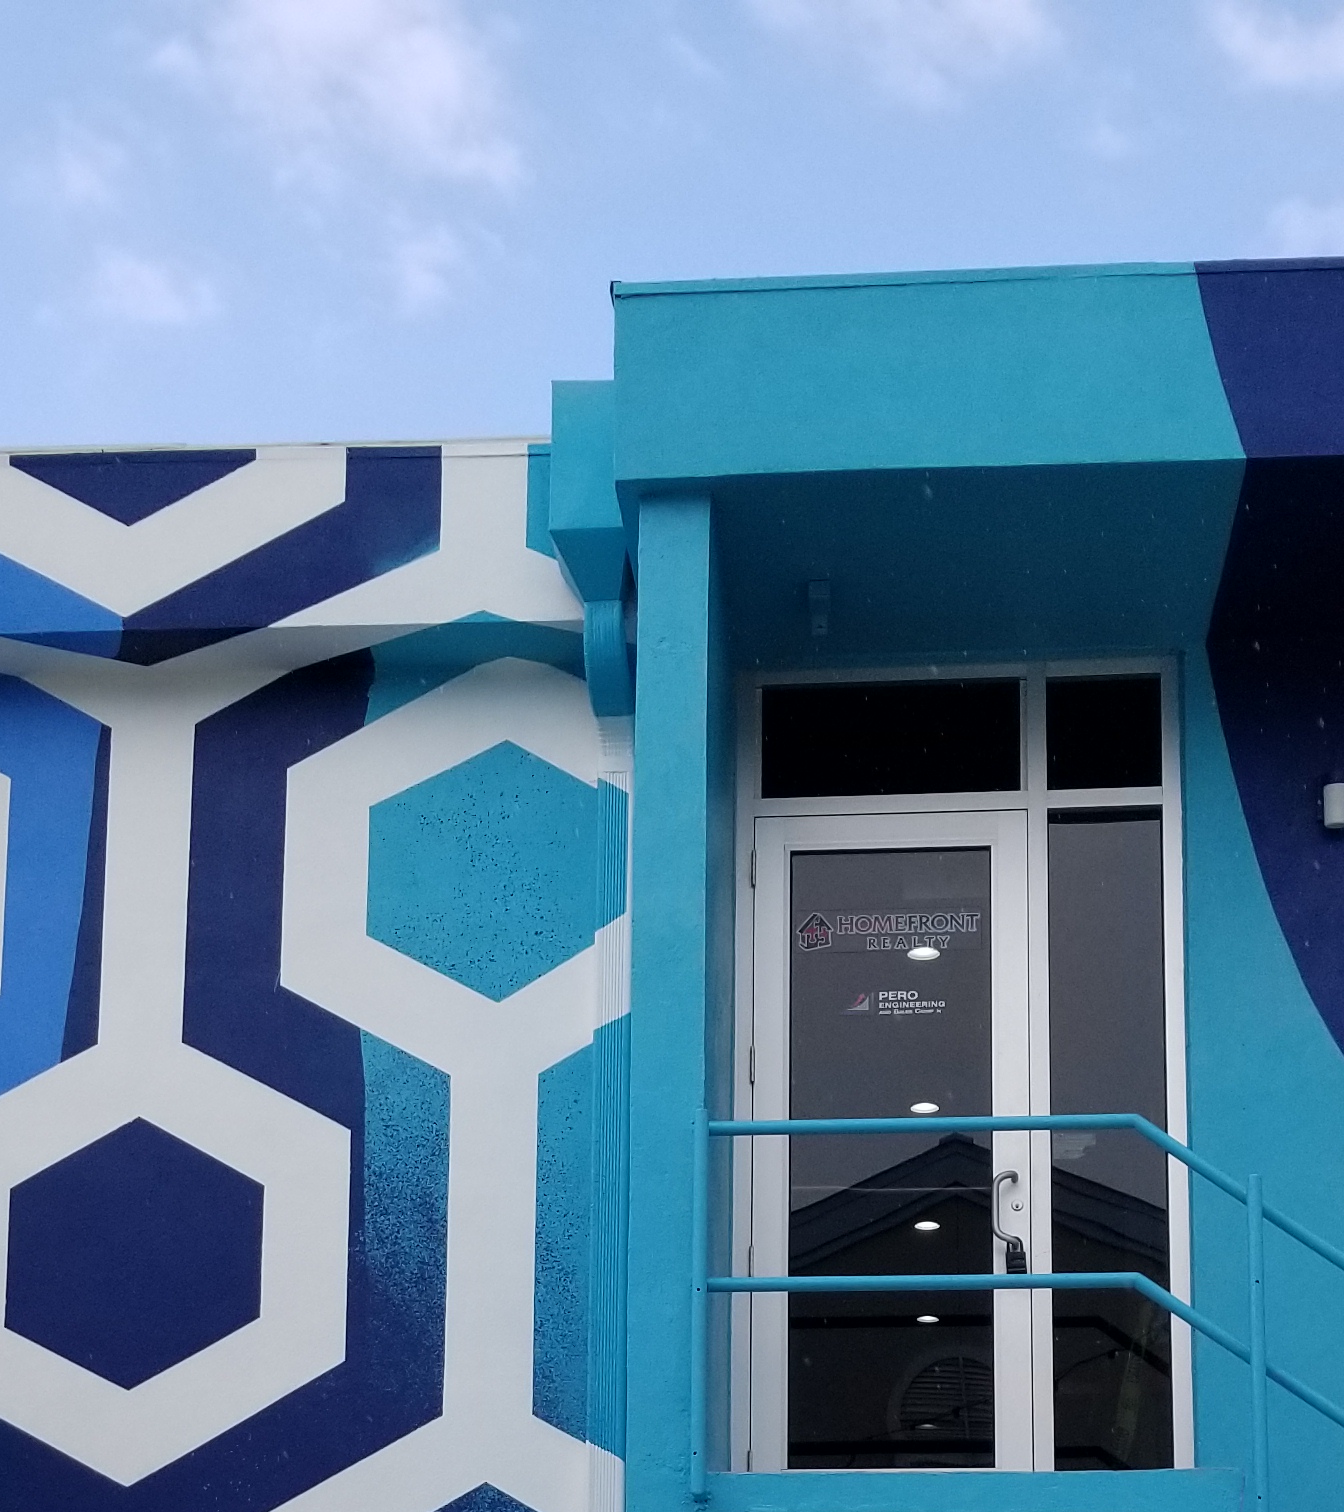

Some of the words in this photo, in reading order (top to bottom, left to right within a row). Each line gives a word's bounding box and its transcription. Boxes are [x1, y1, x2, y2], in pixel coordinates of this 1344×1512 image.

[836, 912, 980, 935] HOMEFRONT
[867, 935, 951, 950] REALTY
[878, 990, 919, 1001] PERO
[878, 1000, 946, 1009] ENGINEERING
